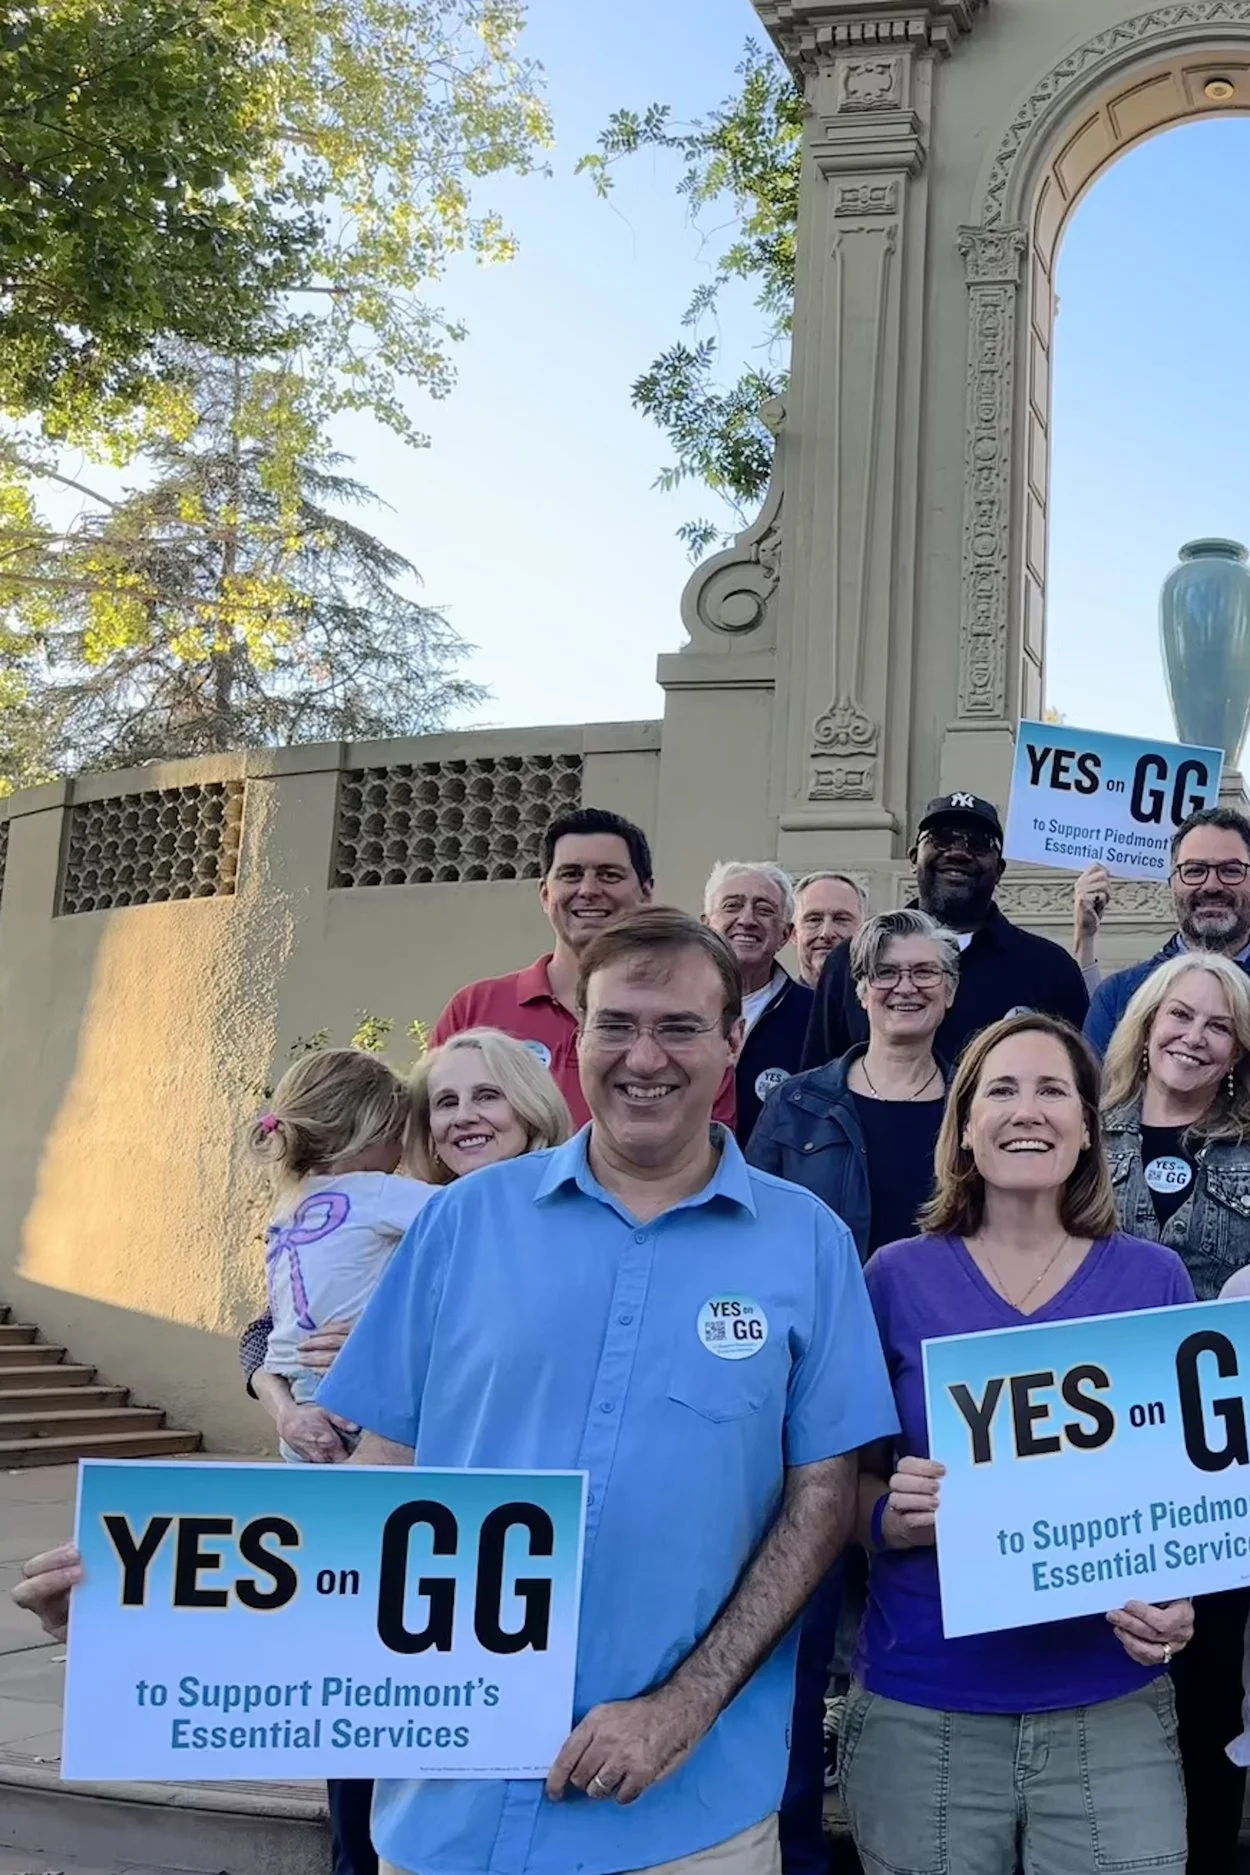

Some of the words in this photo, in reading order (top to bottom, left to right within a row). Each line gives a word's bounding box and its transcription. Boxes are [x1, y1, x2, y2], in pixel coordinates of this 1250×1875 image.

[951, 793, 975, 808] NY
[1026, 744, 1101, 795] YES
[1106, 778, 1125, 793] on
[1130, 754, 1208, 828] GG
[1033, 818, 1045, 831] to
[1049, 819, 1101, 840] Support
[1045, 837, 1103, 860] Essential
[1106, 848, 1165, 869] Services
[765, 1072, 782, 1082] YES
[1156, 1161, 1176, 1170] YES
[1166, 1172, 1187, 1184] GG
[709, 1302, 741, 1317] YES
[733, 1320, 763, 1340] GG
[948, 1364, 1115, 1464] YES
[1129, 1401, 1165, 1428] on
[997, 1528, 1024, 1555] to
[1033, 1509, 1142, 1551] Support
[102, 1515, 300, 1610] YES
[316, 1568, 360, 1595] on
[377, 1500, 554, 1654] GG
[1032, 1545, 1157, 1591] Essential
[136, 1678, 168, 1707] to
[178, 1676, 312, 1713] Support
[322, 1676, 500, 1708] Piedmont's
[171, 1719, 320, 1749] Essential
[331, 1718, 470, 1749] Services
